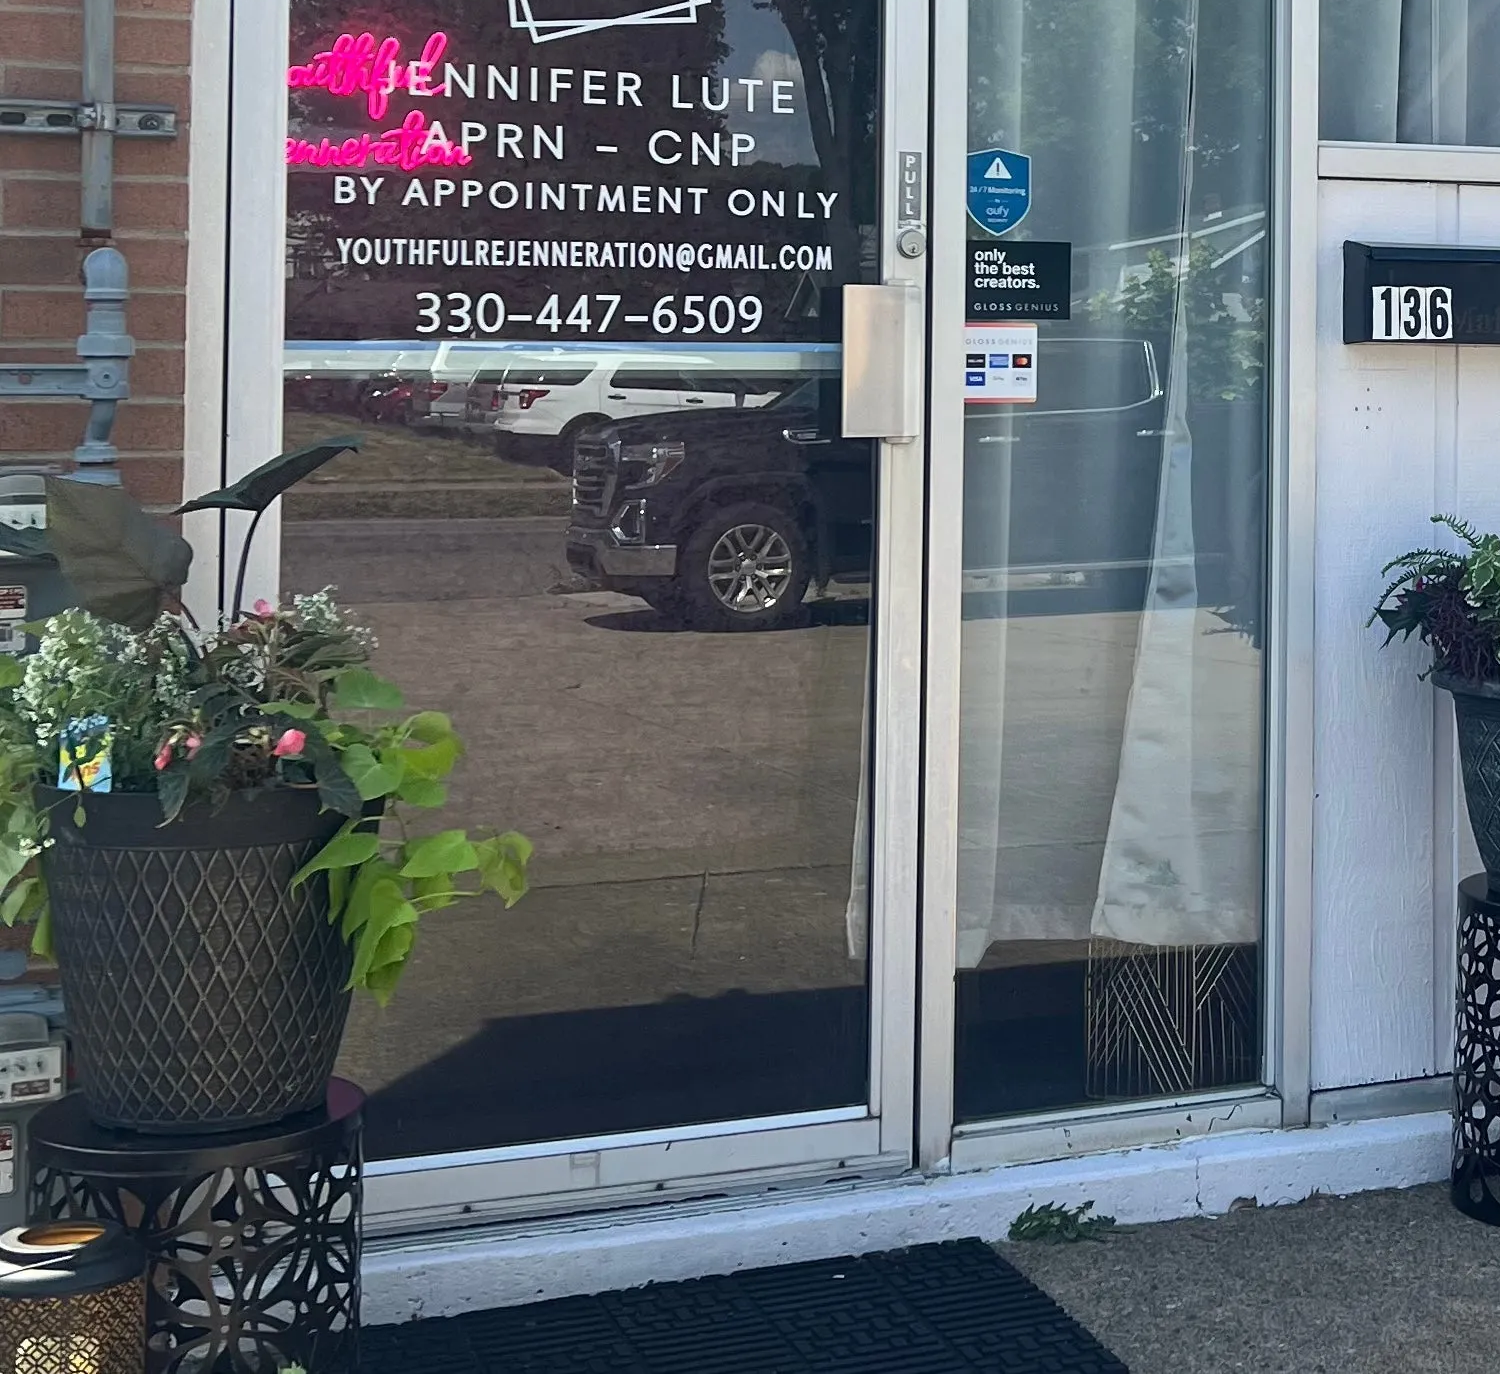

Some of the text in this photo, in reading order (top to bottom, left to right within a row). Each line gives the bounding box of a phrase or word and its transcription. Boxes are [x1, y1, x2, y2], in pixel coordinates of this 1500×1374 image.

[287, 32, 447, 120] outhful
[379, 60, 794, 114] JENNIFER LUTE
[420, 120, 564, 159] APRN
[648, 129, 755, 166] CNP
[334, 176, 839, 219] BY APPOINTMENT ONLY
[905, 155, 916, 216] PULL
[336, 238, 832, 271] YOUTHFULREJENNERATION@GMAIL.COM
[974, 249, 1006, 264] only
[974, 261, 1035, 275] the best
[974, 276, 1040, 289] creators.
[416, 292, 762, 334] 330-447-6509
[1381, 288, 1449, 337] 136
